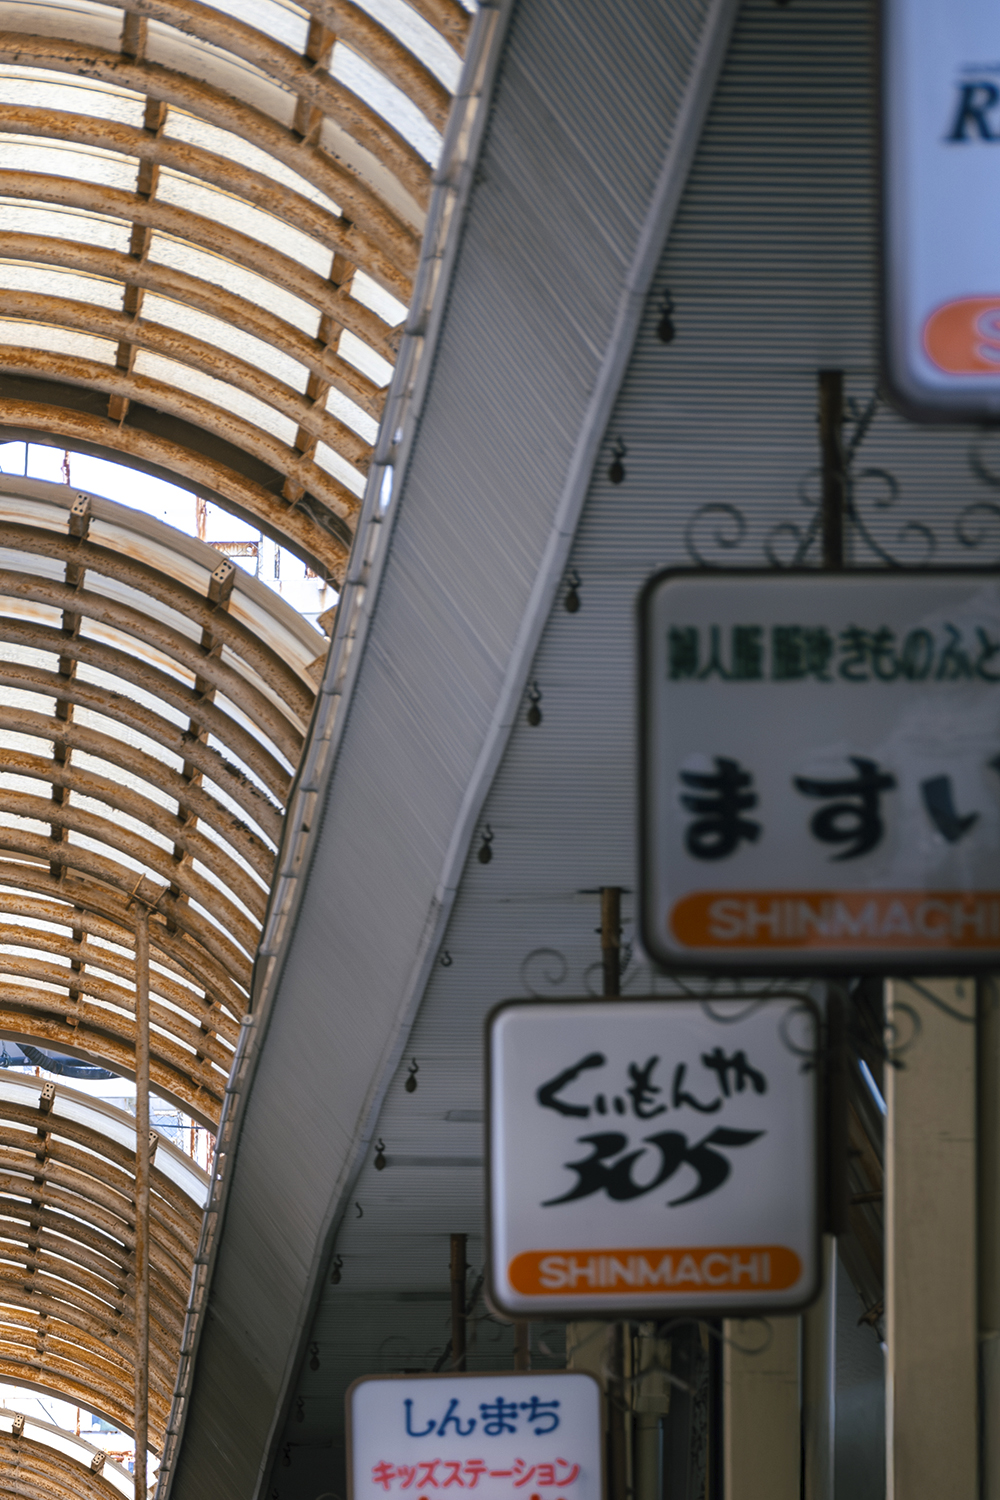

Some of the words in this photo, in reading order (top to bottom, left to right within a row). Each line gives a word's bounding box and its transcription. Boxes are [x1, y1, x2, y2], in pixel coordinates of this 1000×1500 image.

[537, 1048, 767, 1119] くいもんや
[538, 1252, 771, 1289] SHINMACHI
[404, 1396, 560, 1436] しんまち
[373, 1459, 579, 1489] キッズステーション
